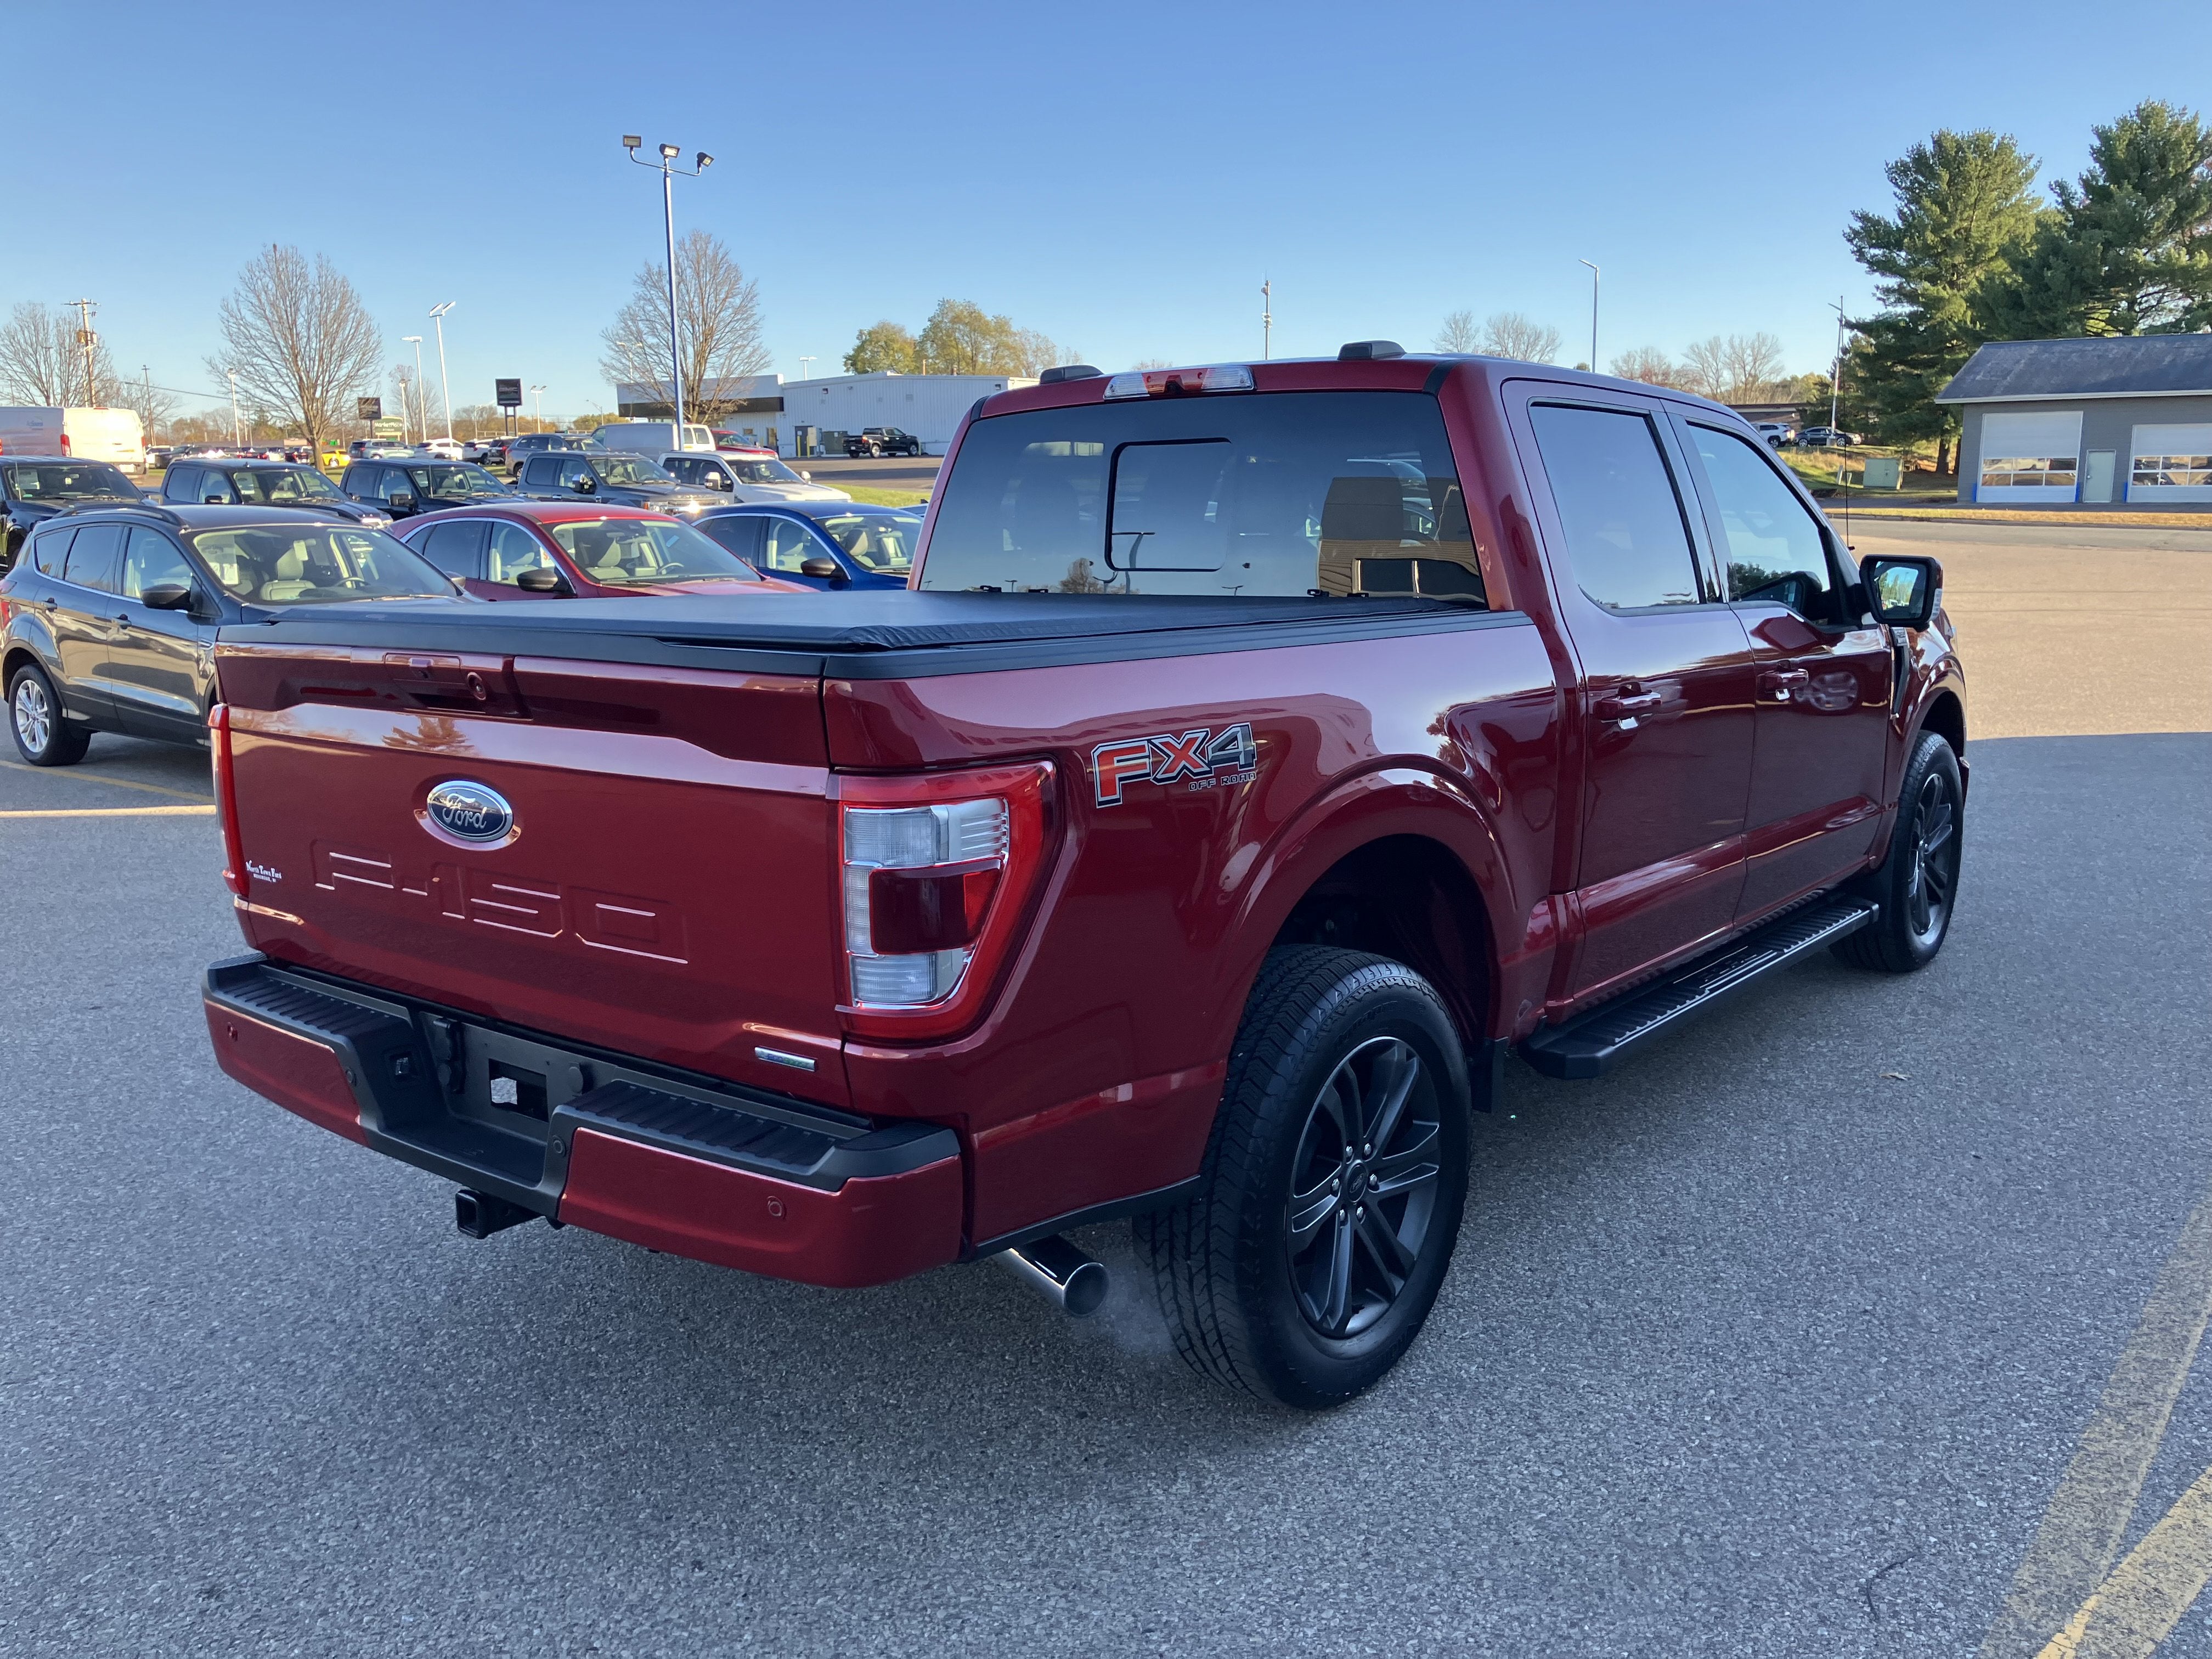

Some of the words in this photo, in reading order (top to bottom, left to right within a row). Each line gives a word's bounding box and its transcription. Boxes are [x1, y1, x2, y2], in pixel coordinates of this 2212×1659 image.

[1091, 722, 1257, 809] FX4
[1189, 778, 1216, 792] OFF
[1220, 771, 1257, 786] ROAD
[441, 793, 487, 829] Ford
[309, 838, 689, 964] F-150
